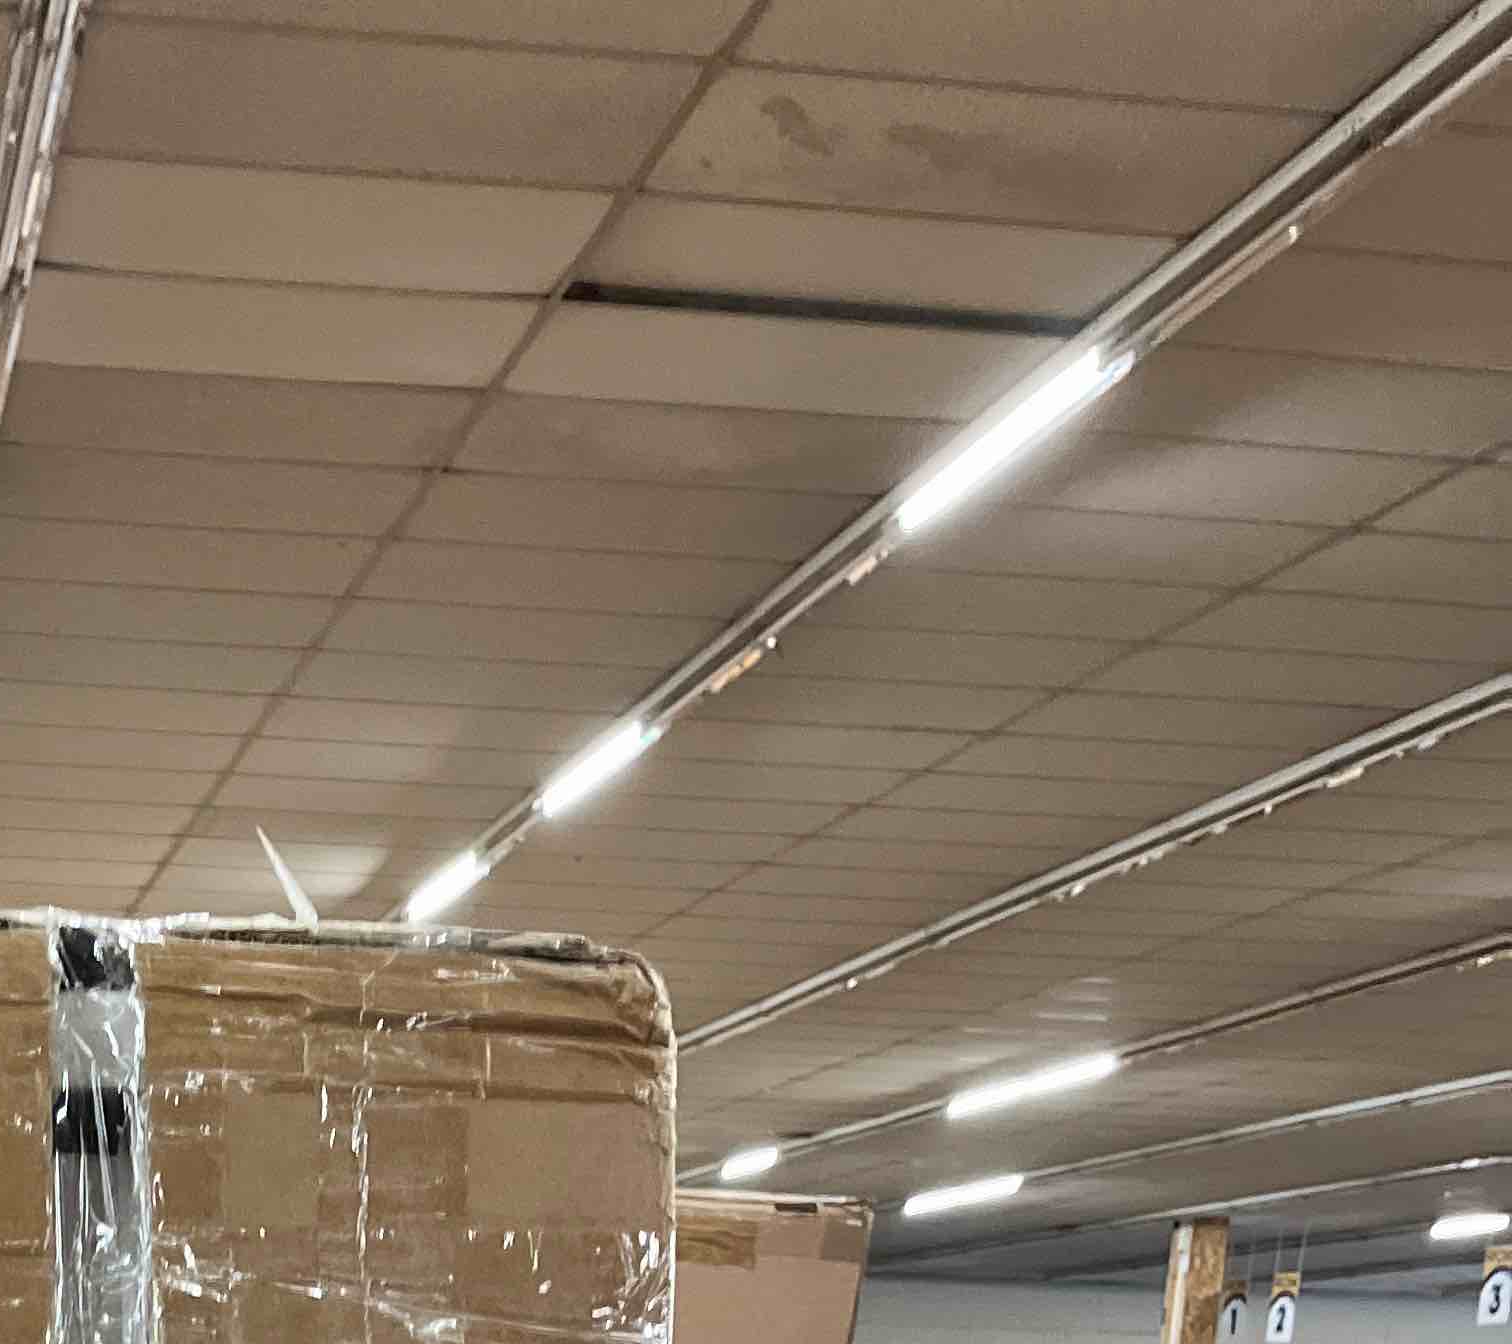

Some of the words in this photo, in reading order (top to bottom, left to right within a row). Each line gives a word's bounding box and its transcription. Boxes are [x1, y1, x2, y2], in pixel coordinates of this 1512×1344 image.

[1489, 1285, 1501, 1315] 3
[1231, 1308, 1238, 1336] 1
[1276, 1307, 1287, 1333] 2
